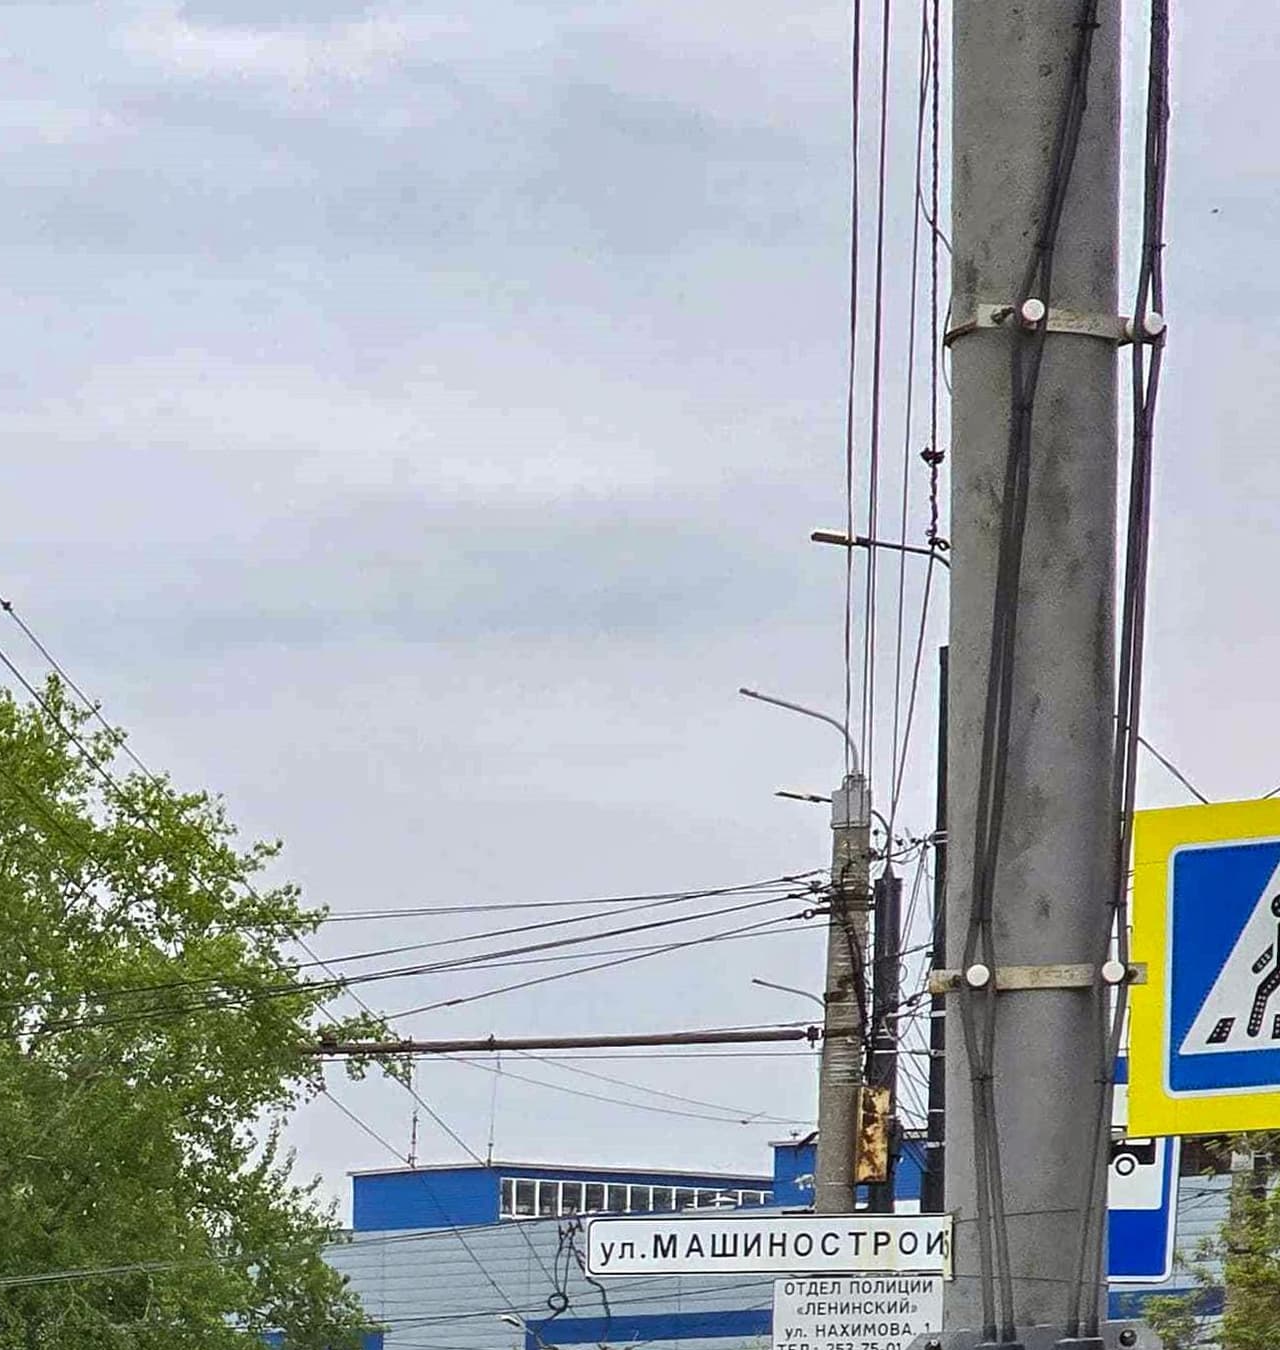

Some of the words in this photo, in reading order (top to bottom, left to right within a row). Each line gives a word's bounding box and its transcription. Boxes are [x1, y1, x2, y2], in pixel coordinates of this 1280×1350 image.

[784, 1281, 841, 1296] ОТДЕЛ
[849, 1280, 933, 1296] ПОЛИЦИИ
[796, 1298, 918, 1316] «ЛЕНИНСКИЙ»
[784, 1328, 808, 1340] ул.
